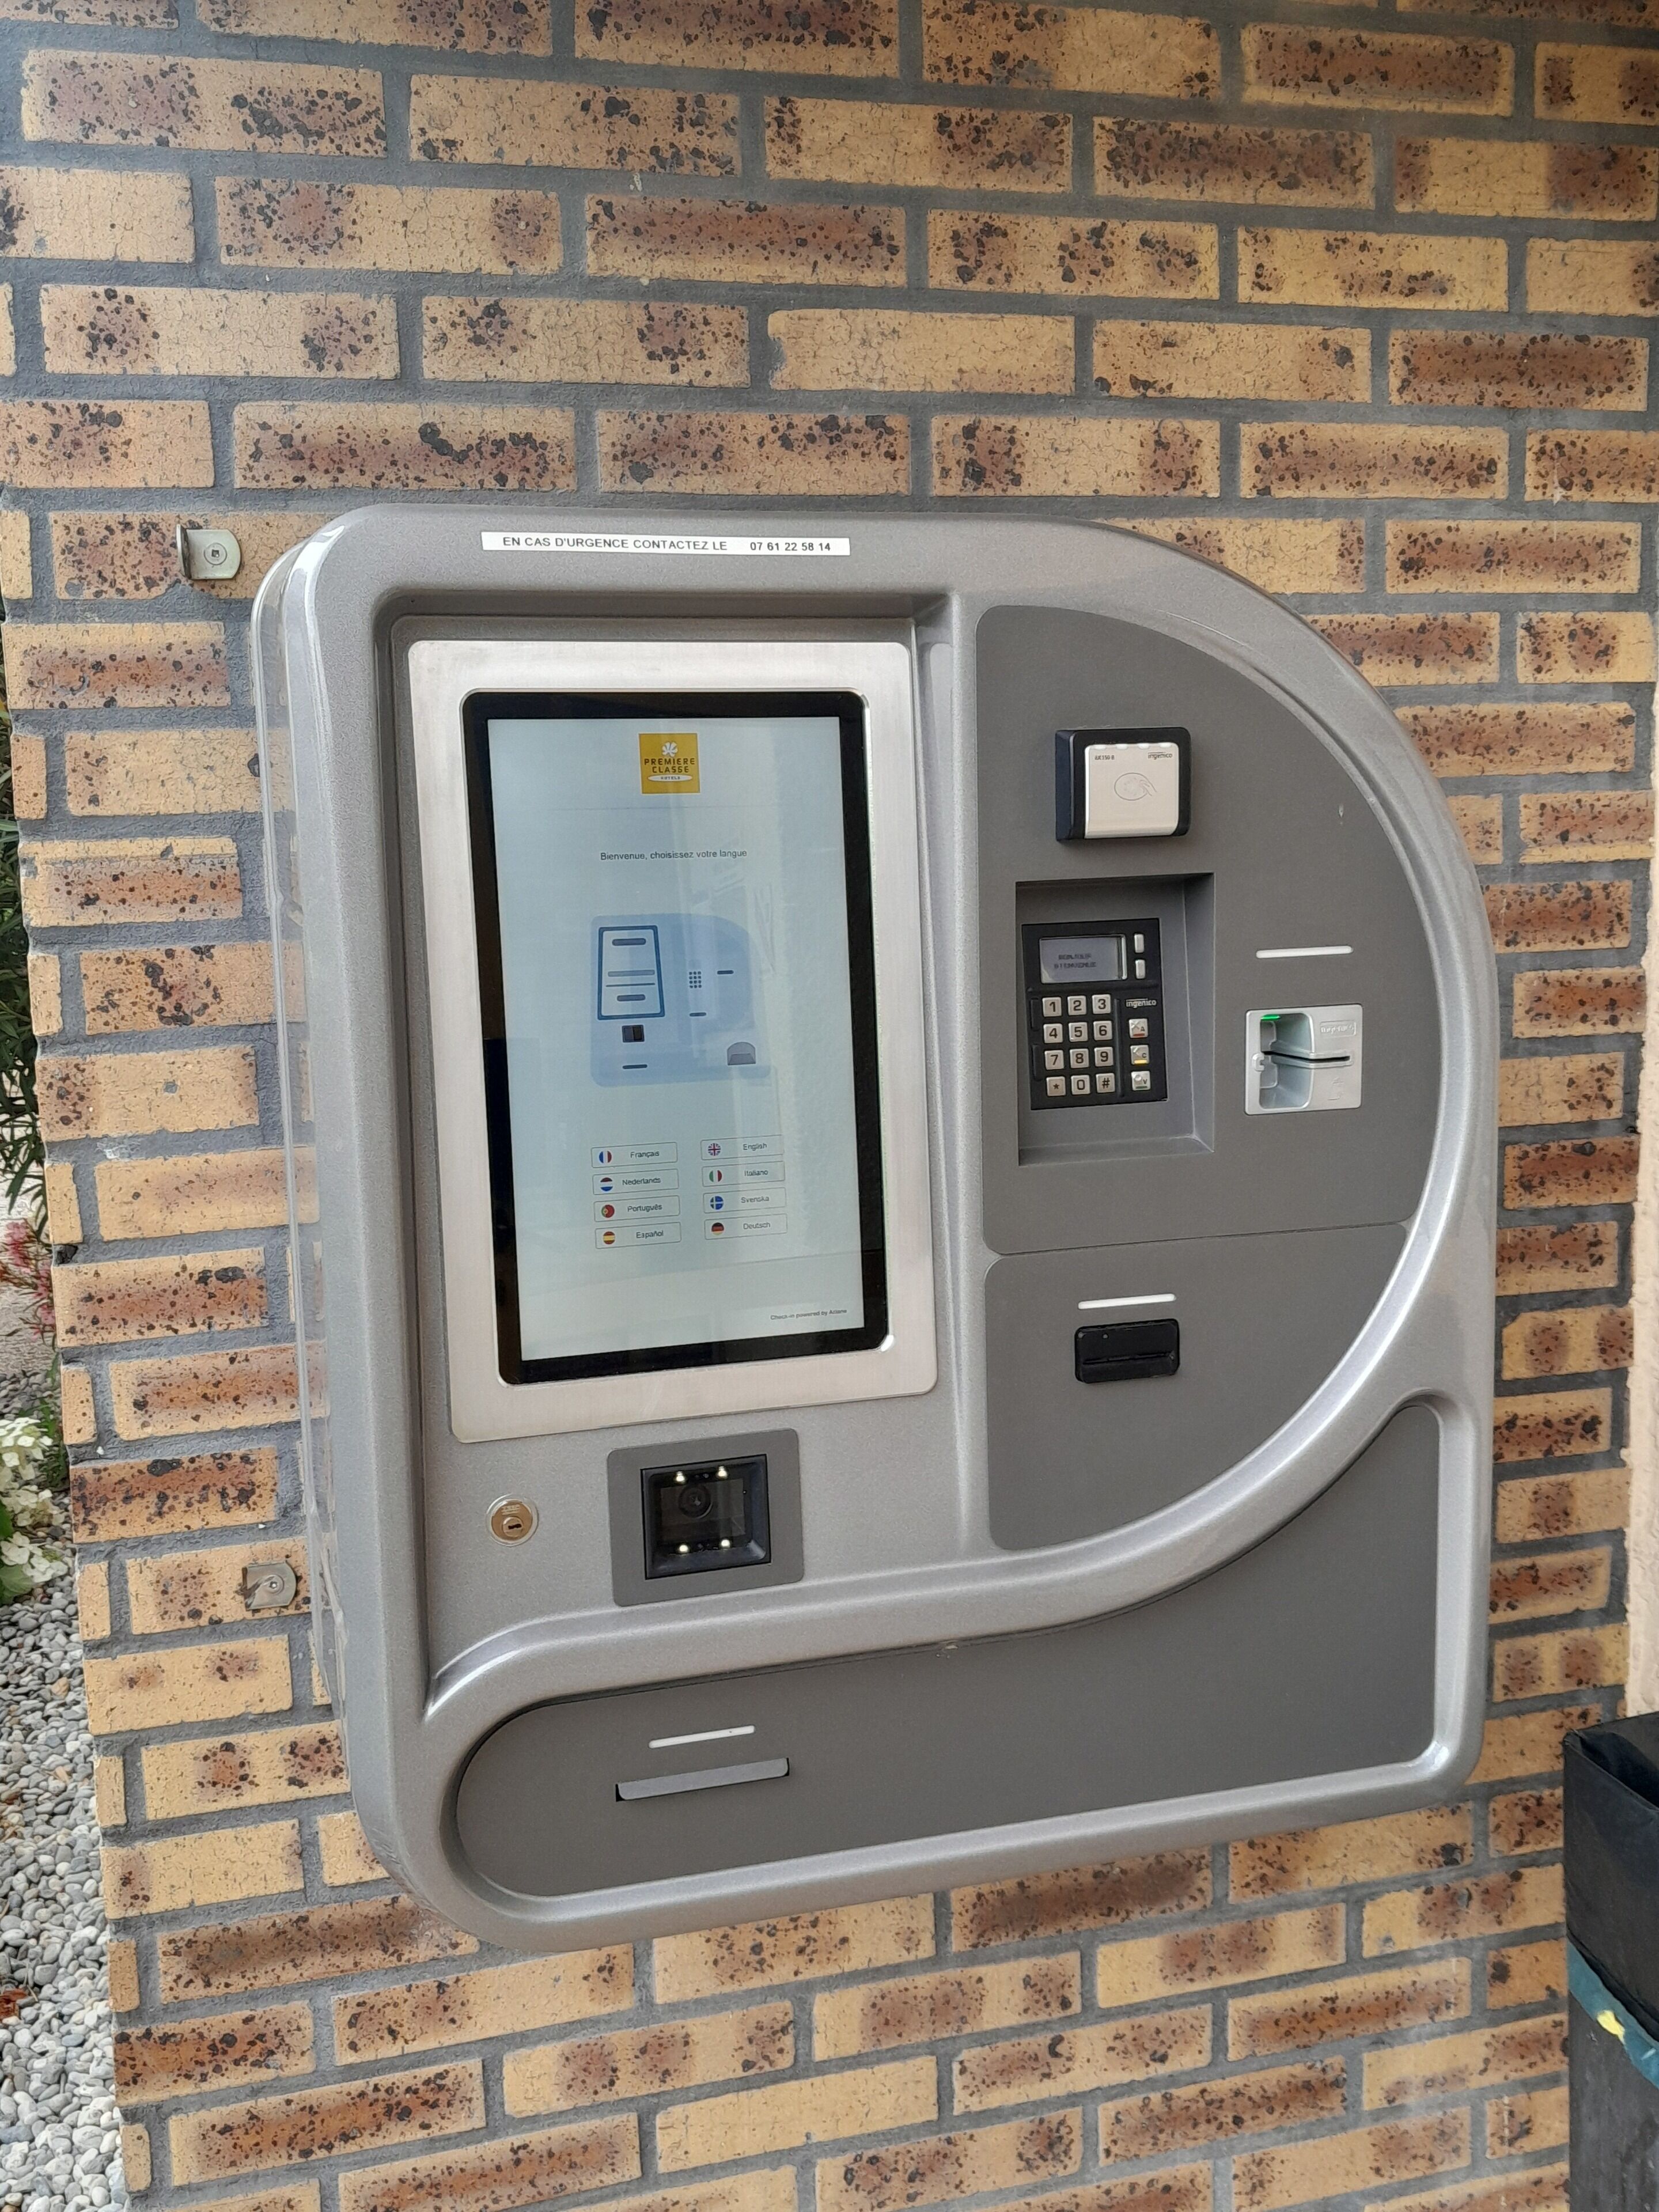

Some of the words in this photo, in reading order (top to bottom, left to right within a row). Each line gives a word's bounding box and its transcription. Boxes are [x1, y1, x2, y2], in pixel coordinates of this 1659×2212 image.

[502, 536, 521, 546] EN
[524, 537, 551, 547] CAS
[555, 537, 629, 548] D'URGENCE
[633, 539, 709, 550] CONTACTEZ
[713, 541, 728, 551] LE
[750, 541, 763, 551] 07
[767, 542, 780, 551] 61
[784, 542, 798, 551] 22
[801, 542, 815, 551] 58
[819, 543, 831, 552] 14
[643, 757, 696, 766] PREMIERE
[652, 766, 690, 774] CLASSE
[600, 852, 648, 861] Bienvenue,
[649, 851, 694, 859] choisissez
[719, 849, 748, 859] langue
[1049, 1001, 1056, 1013] 1
[1073, 999, 1082, 1012] 2
[1097, 998, 1106, 1010] 3
[1126, 998, 1157, 1008] ingenico
[1048, 1027, 1058, 1039] 4
[1074, 1026, 1082, 1038] 5
[1099, 1025, 1107, 1036] 6
[1050, 1054, 1059, 1066] 7
[1075, 1052, 1084, 1064] 8
[1100, 1051, 1109, 1063] 9
[1076, 1078, 1085, 1090] 0
[1101, 1077, 1111, 1089] #
[743, 1142, 767, 1152] English
[630, 1150, 660, 1158] Français
[744, 1169, 768, 1177] Italiano
[622, 1176, 661, 1186] Nederlands
[741, 1195, 770, 1203] Svenska
[627, 1203, 662, 1213] Português
[743, 1221, 771, 1230] Deutsch
[636, 1230, 664, 1240] Español
